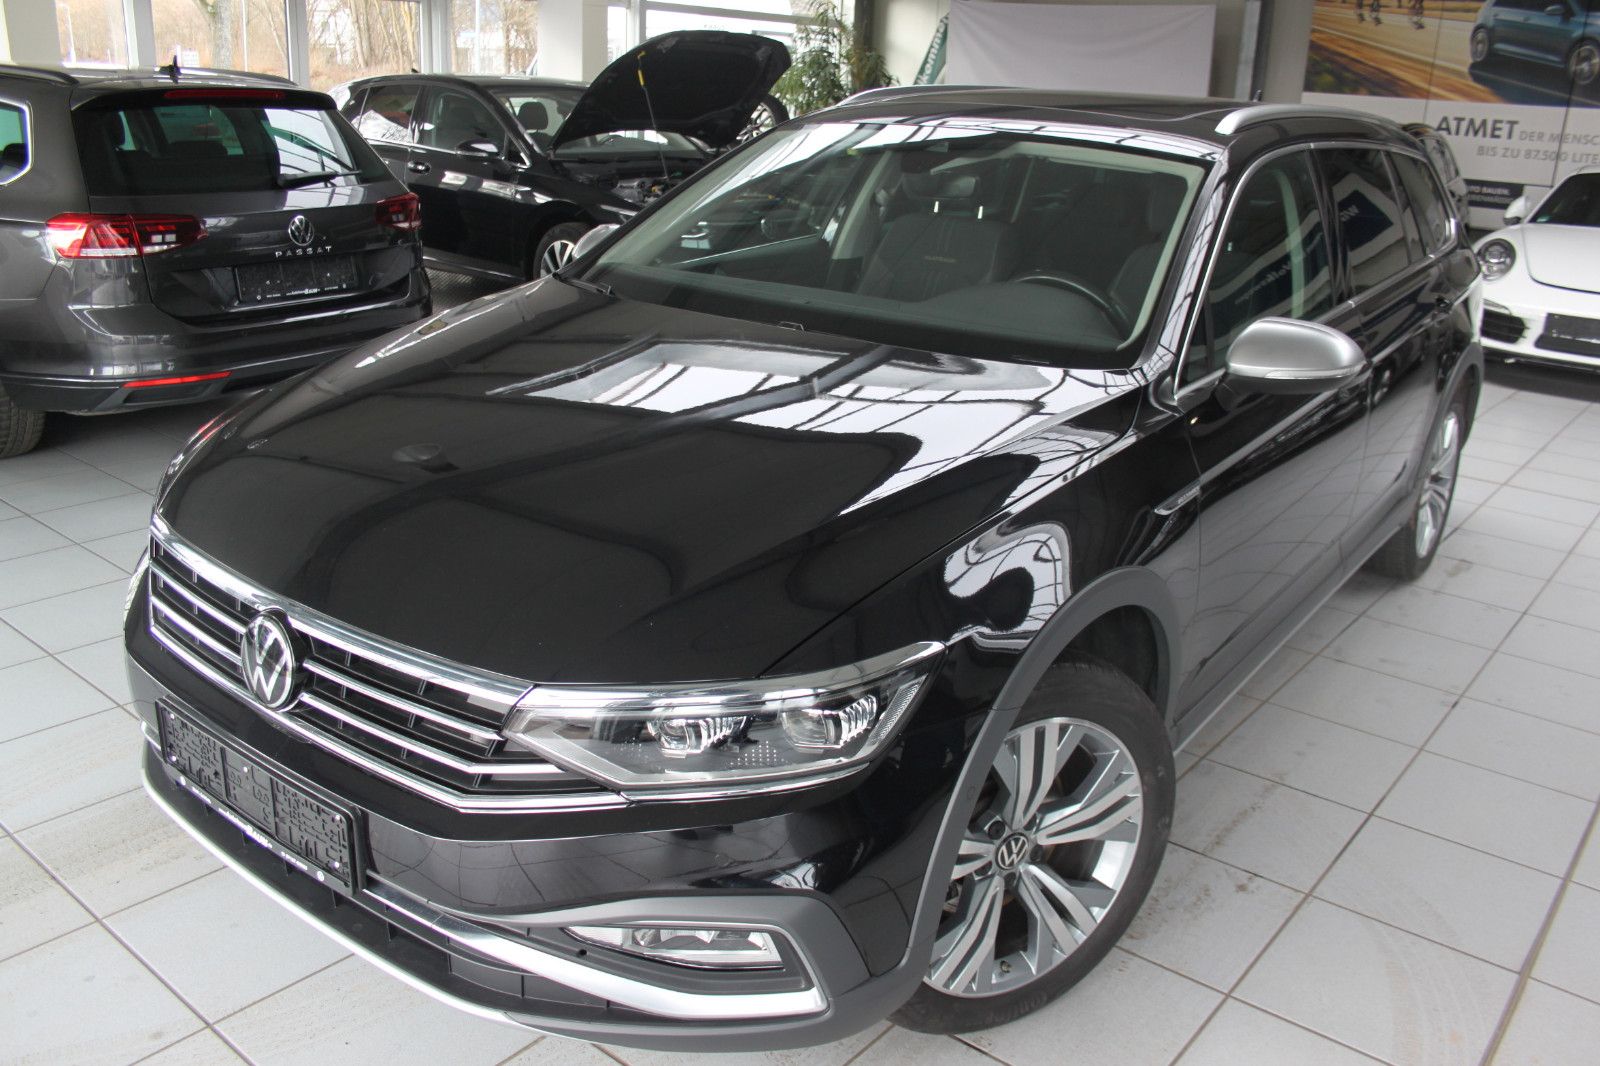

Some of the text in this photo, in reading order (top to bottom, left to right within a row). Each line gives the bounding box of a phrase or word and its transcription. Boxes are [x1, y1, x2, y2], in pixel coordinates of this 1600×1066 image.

[1436, 116, 1519, 140] ATMET
[1519, 130, 1544, 142] DER
[1476, 146, 1498, 157] BIS
[1501, 148, 1519, 158] ZU
[275, 245, 332, 258] PASSAT
